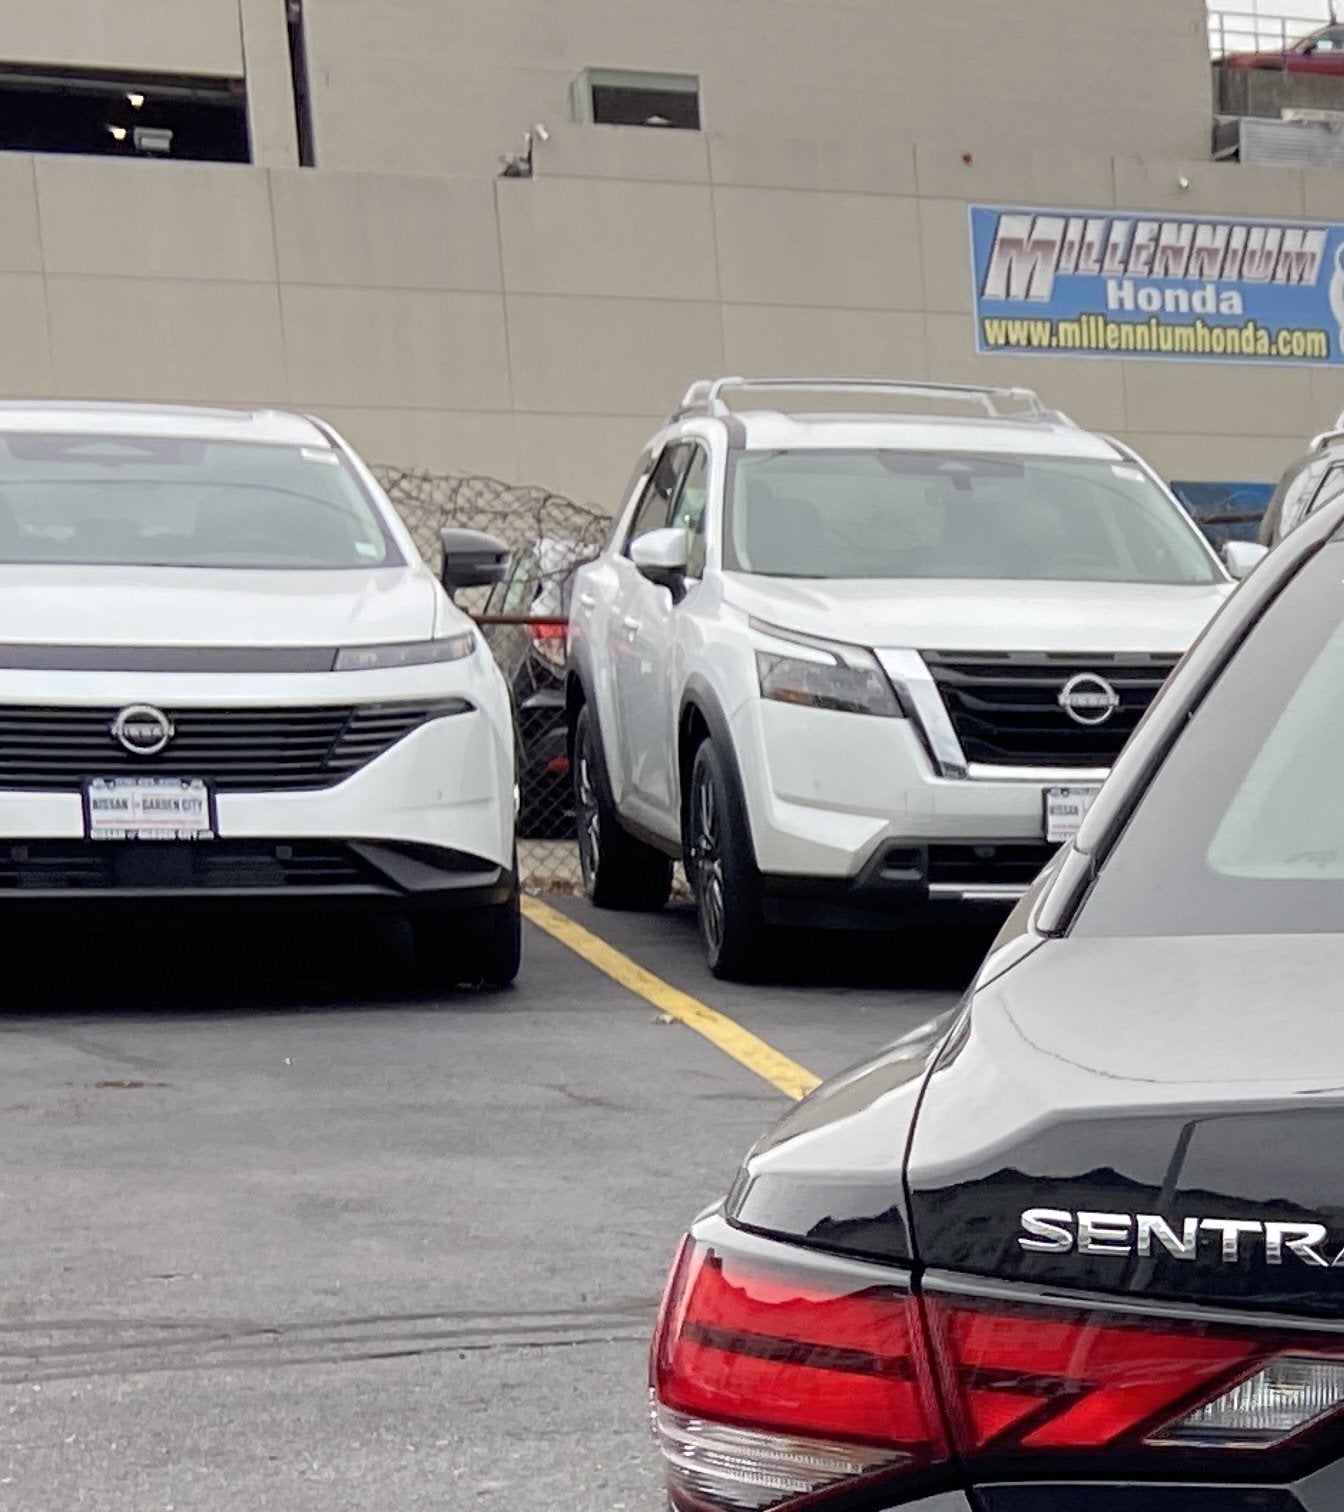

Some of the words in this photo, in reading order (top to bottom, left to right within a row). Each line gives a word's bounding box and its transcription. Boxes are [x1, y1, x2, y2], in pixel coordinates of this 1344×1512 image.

[981, 214, 1328, 302] MILLENNIUM
[1106, 279, 1243, 315] Honda
[983, 314, 1328, 358] www.millenniumhonda.com
